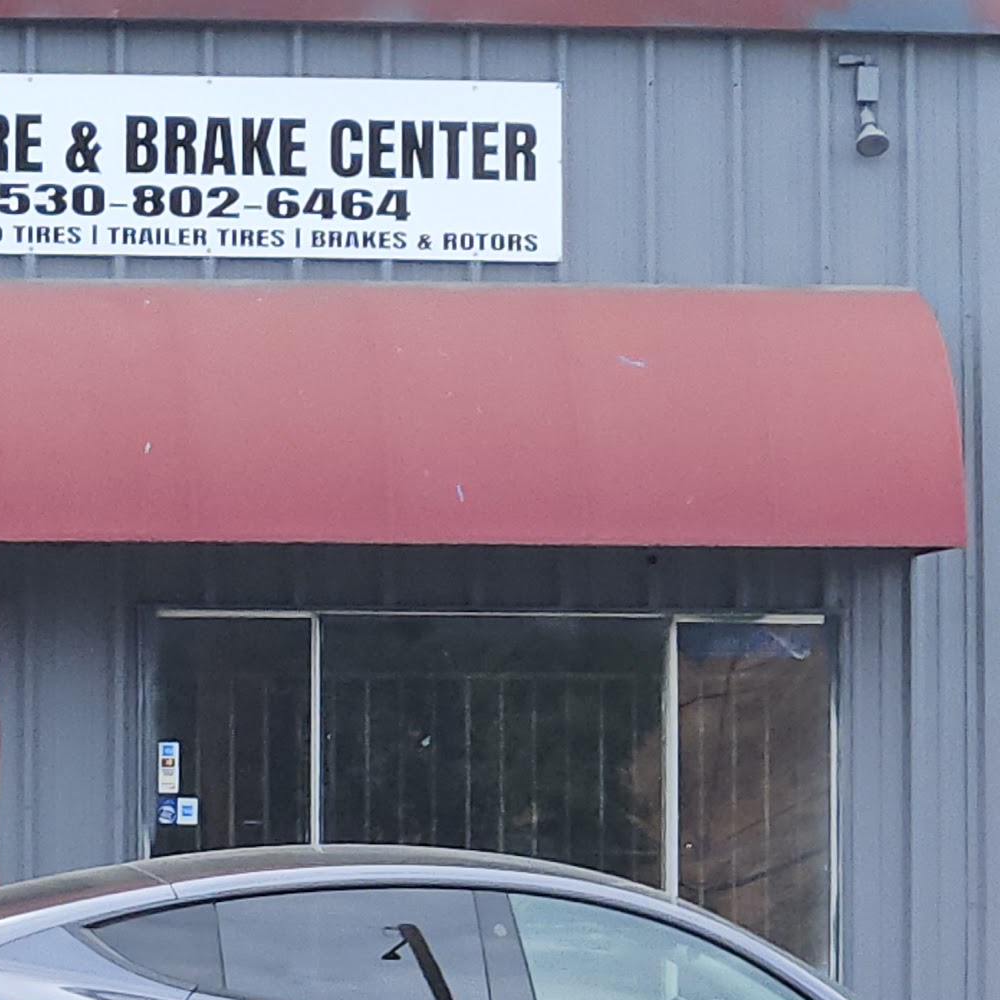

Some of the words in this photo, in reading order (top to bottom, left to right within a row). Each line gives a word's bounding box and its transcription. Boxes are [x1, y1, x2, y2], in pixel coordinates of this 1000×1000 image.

[65, 120, 102, 174] &
[125, 115, 307, 177] BRAKE
[330, 119, 537, 181] CENTER
[13, 225, 82, 244] TIRES
[107, 227, 207, 246] TRAILER
[217, 228, 285, 247] TIRES
[311, 230, 407, 249] BRAKES
[417, 234, 432, 250] &
[443, 233, 538, 252] ROTORS
